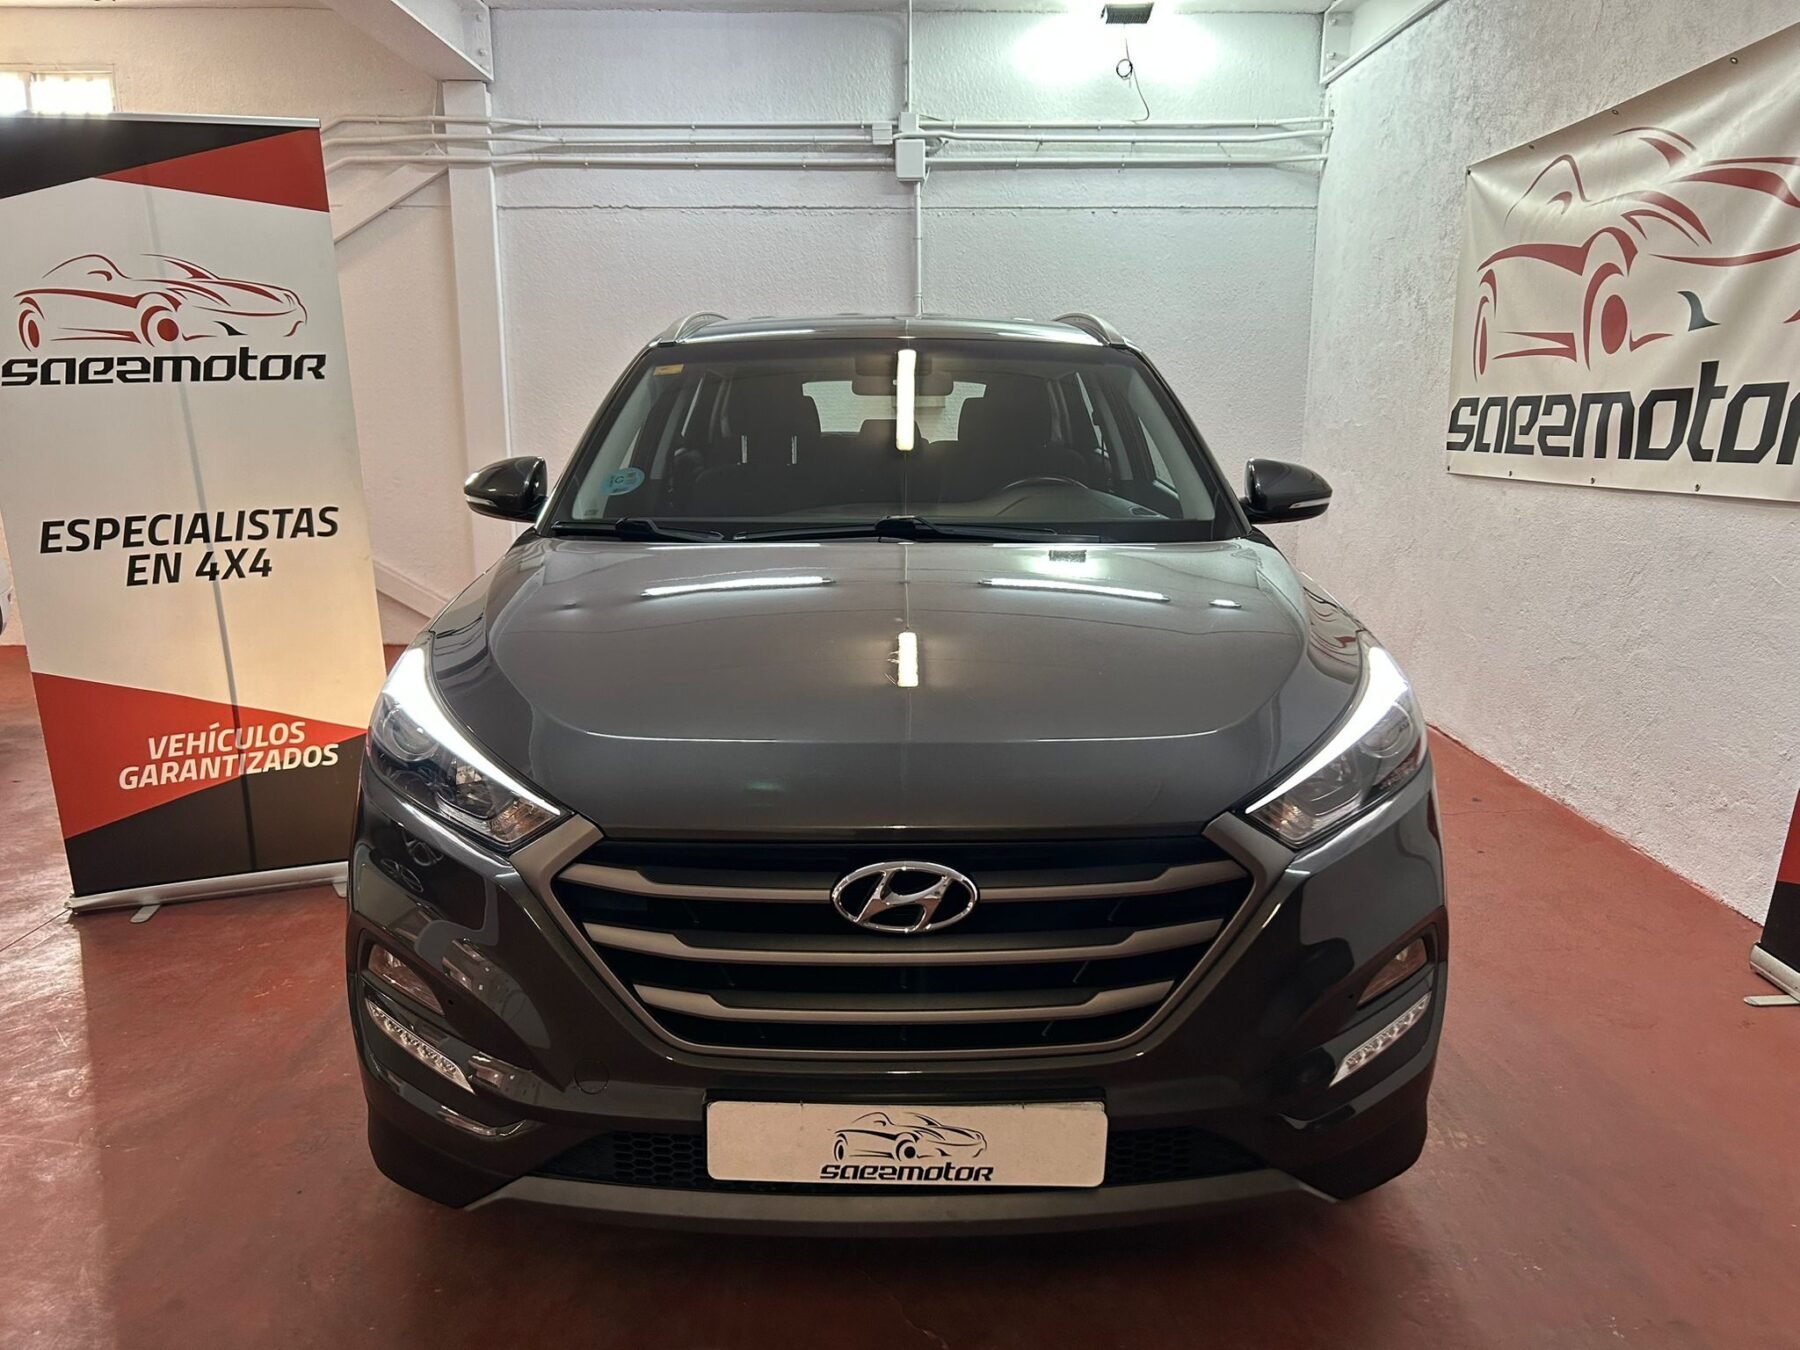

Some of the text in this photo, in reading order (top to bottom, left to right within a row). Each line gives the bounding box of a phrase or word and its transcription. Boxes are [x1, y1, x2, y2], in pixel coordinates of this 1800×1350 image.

[39, 506, 339, 554] ESPECIALISTAS
[126, 548, 272, 587] EN 4X4
[148, 721, 306, 760] VEHÍCULOS
[118, 743, 339, 791] GARANTIZADOS
